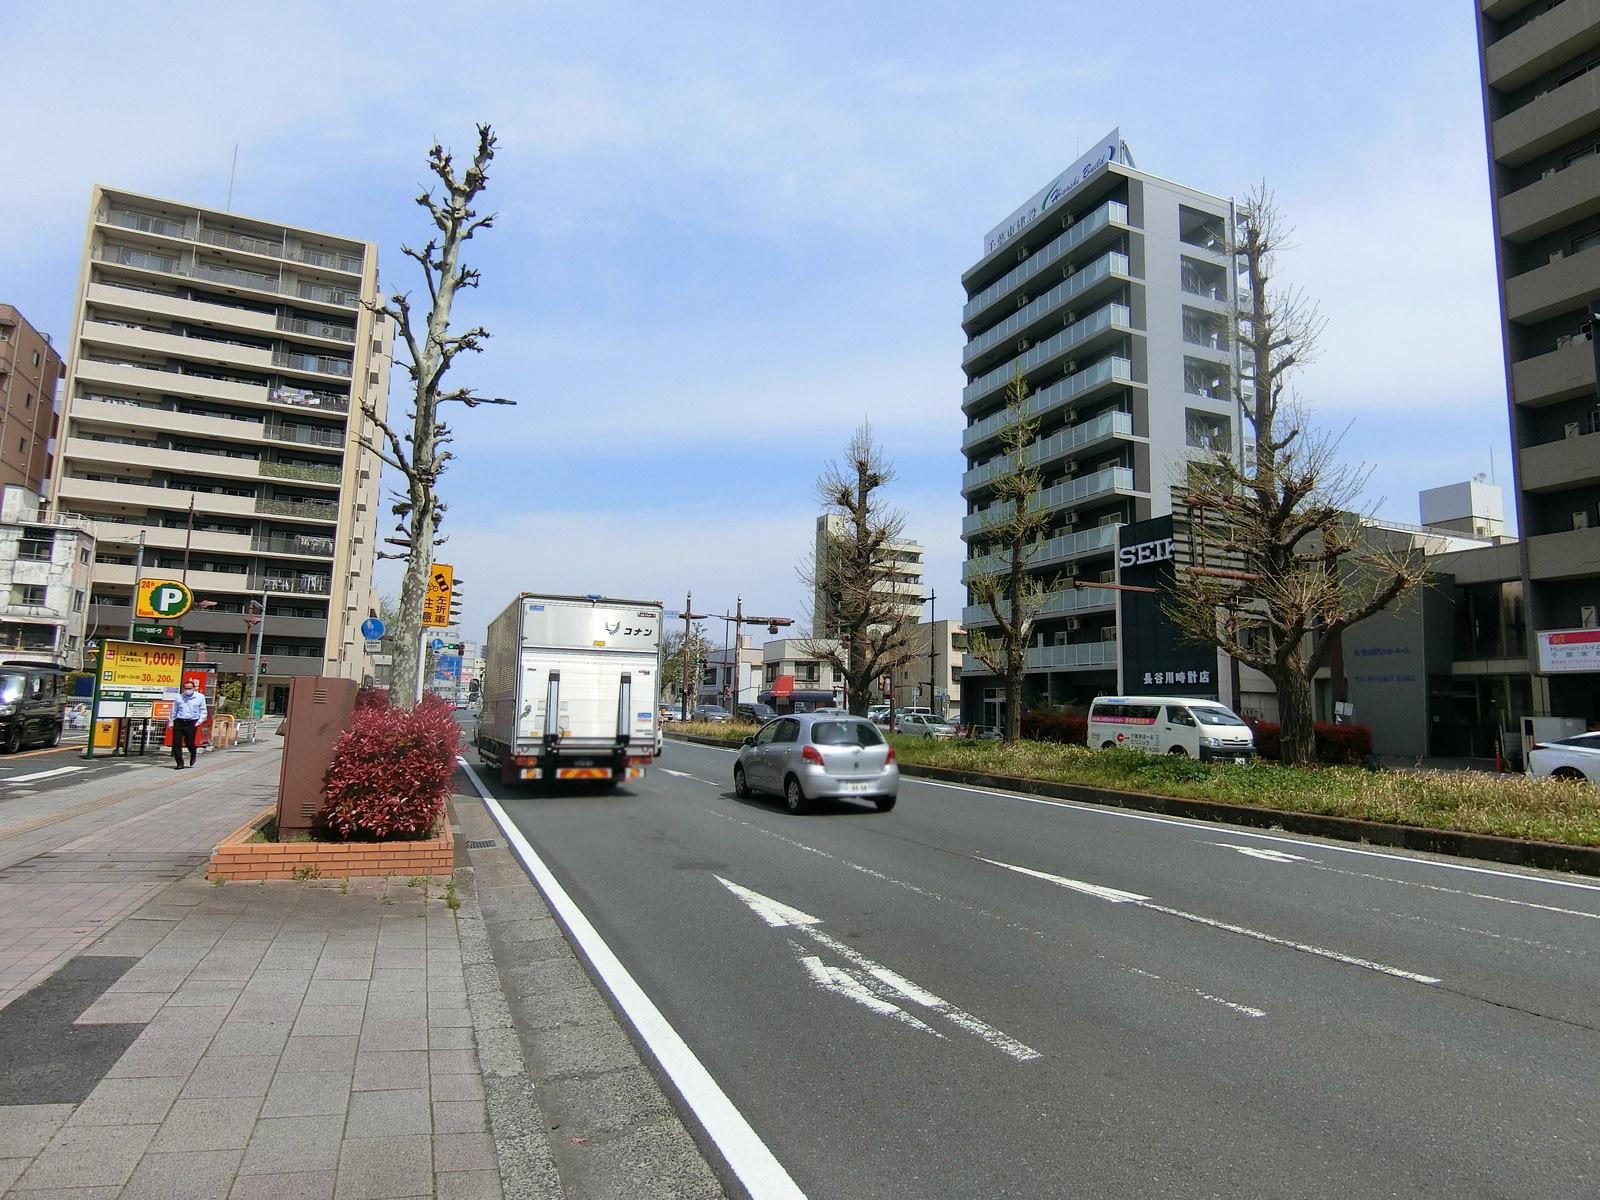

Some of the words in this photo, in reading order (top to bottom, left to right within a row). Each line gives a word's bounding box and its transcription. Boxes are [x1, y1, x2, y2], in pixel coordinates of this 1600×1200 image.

[160, 587, 183, 612] P
[434, 595, 448, 624] 左折車
[623, 627, 653, 637] コナン
[1143, 671, 1210, 684] 長谷川時計店
